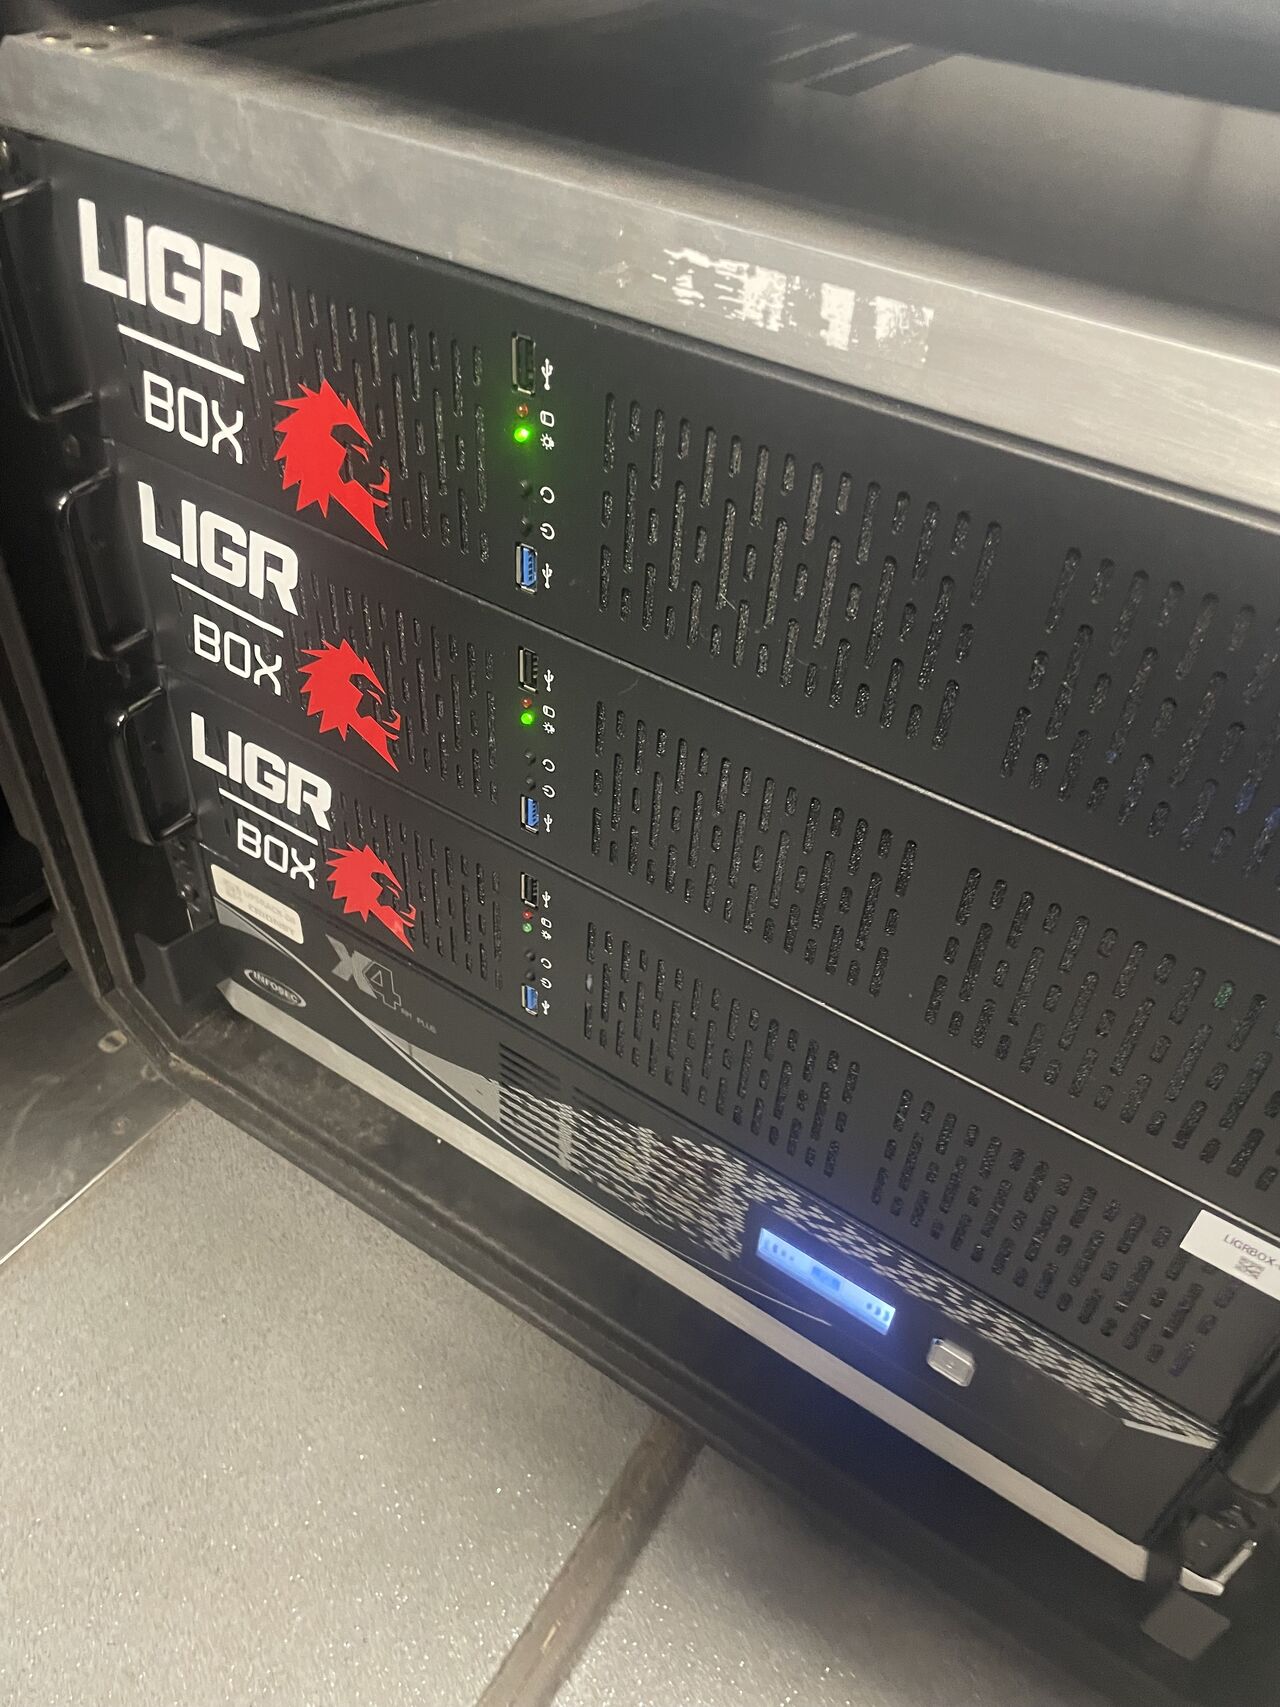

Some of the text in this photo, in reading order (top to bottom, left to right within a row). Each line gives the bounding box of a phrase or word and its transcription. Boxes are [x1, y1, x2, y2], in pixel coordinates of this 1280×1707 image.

[78, 198, 261, 352] LIGR
[143, 370, 244, 465] BOX
[138, 481, 298, 616] LIGR
[193, 613, 282, 696] BOX
[191, 712, 332, 832] LIGR
[237, 818, 316, 890] BOX
[252, 970, 298, 1004] INFOSEC
